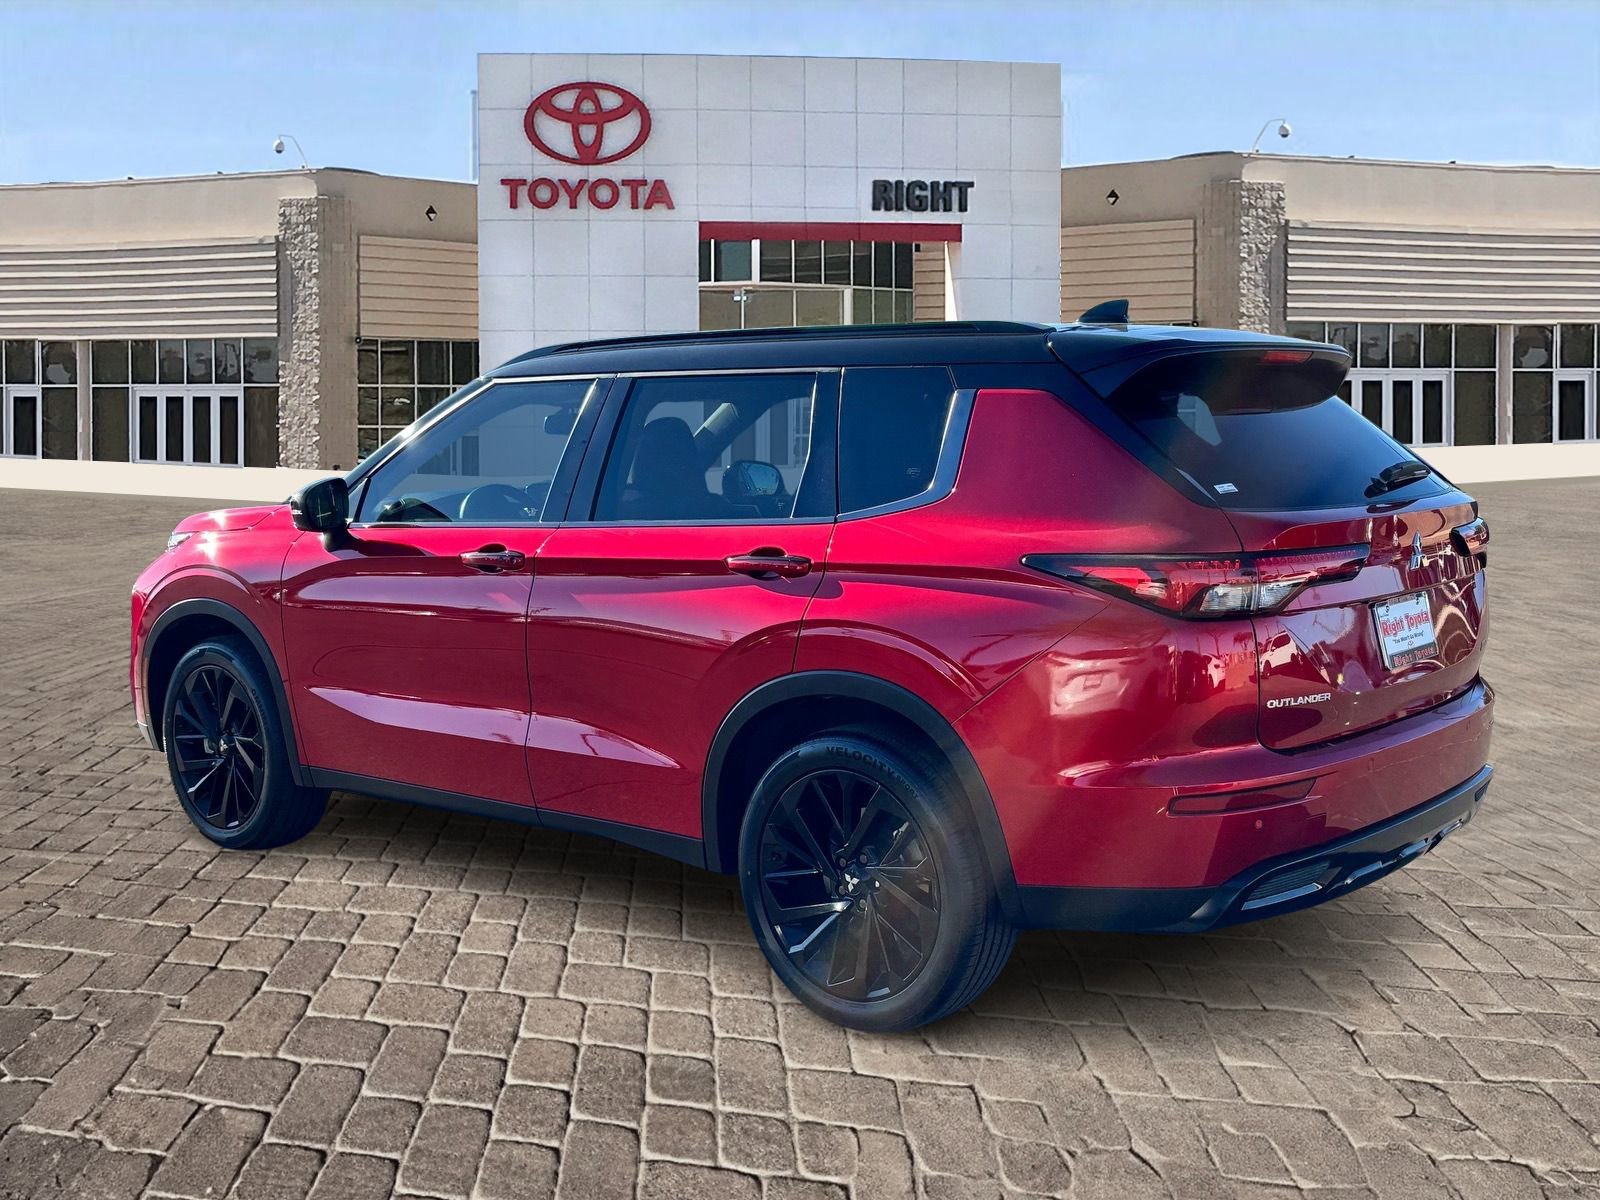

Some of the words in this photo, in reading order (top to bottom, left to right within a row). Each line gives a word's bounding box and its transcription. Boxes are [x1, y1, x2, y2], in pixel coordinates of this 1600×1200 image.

[500, 178, 675, 209] TOYOTA
[872, 180, 974, 212] RIGHT
[1381, 616, 1404, 637] Right
[1405, 610, 1430, 631] Toyota
[1266, 692, 1331, 708] OUTLANDER
[826, 746, 896, 778] VELOCITY
